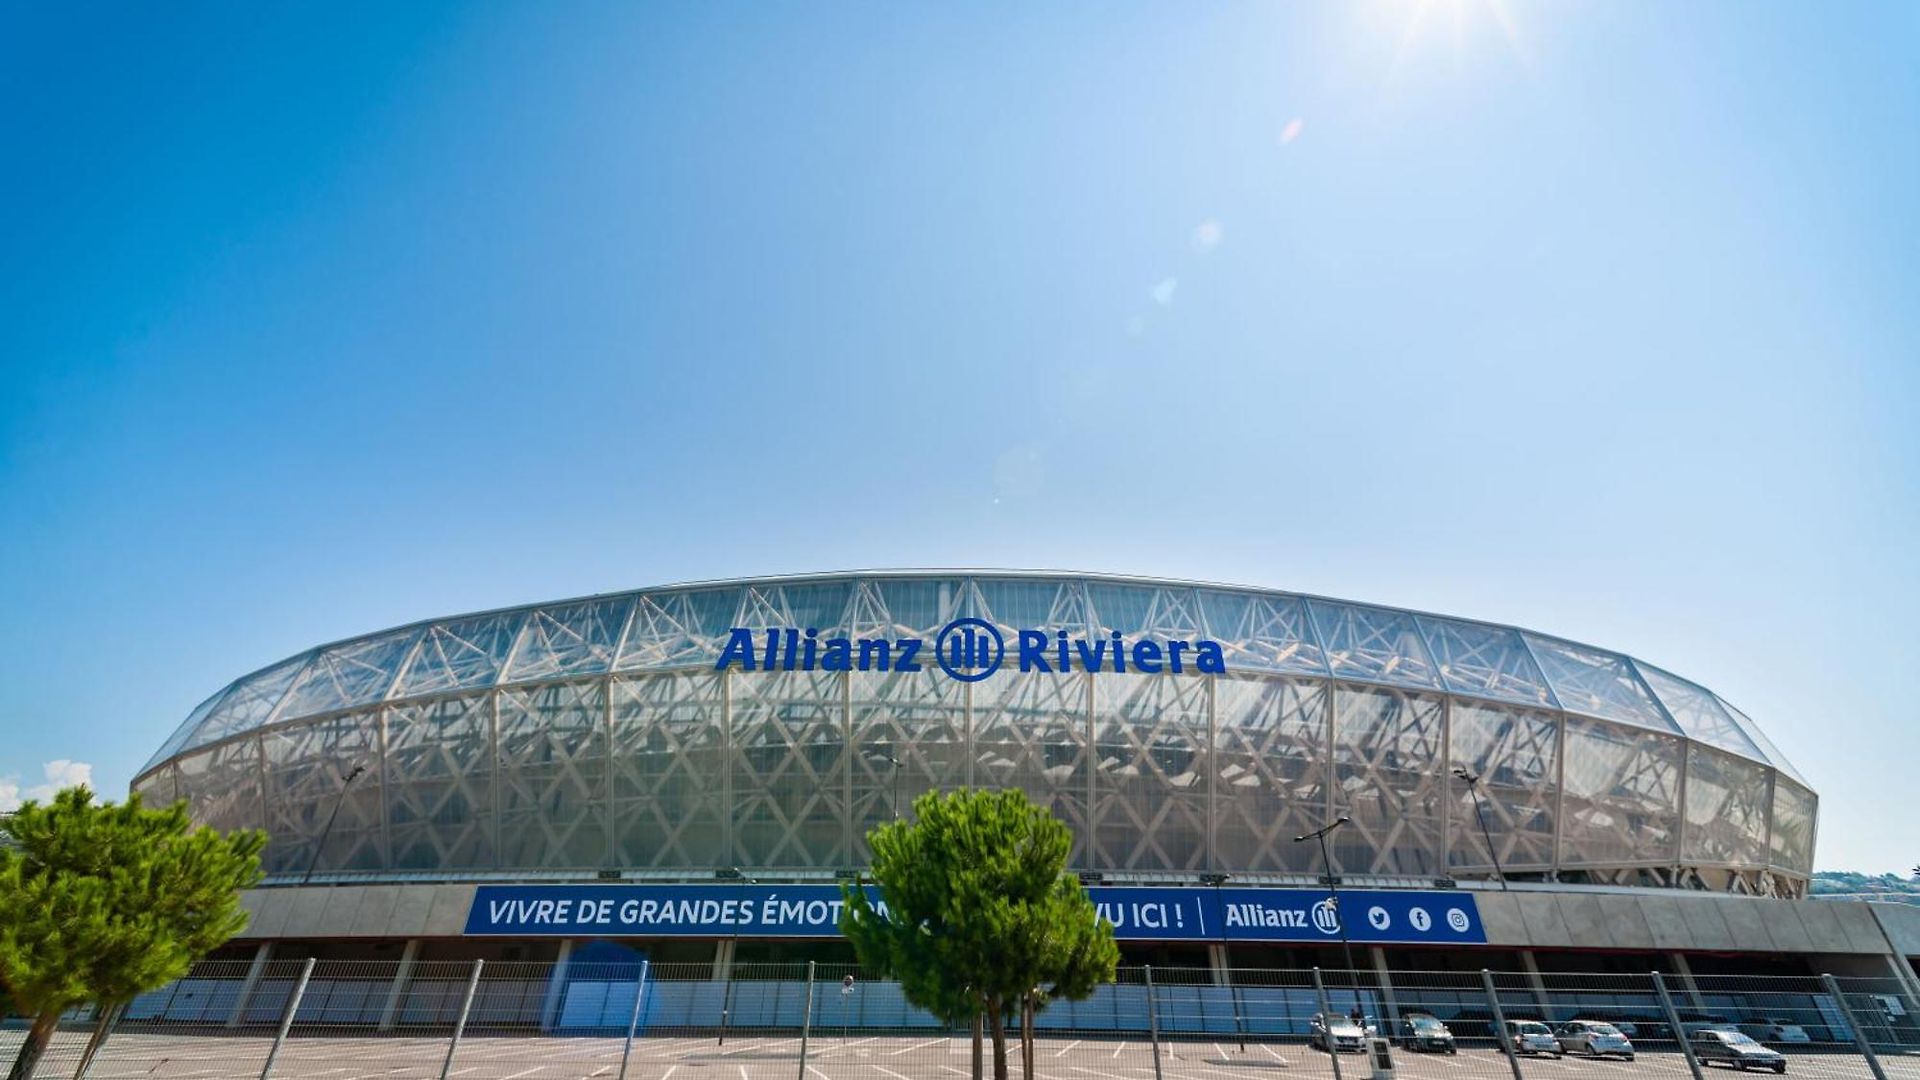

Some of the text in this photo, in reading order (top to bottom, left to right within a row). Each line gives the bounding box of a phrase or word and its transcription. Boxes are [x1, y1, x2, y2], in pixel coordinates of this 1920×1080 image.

[717, 627, 1226, 673] Allianz Riviera
[490, 900, 572, 925] VIVRE
[577, 900, 614, 925] DE
[620, 899, 754, 925] GRANDES
[1132, 903, 1168, 928] ICI
[1226, 904, 1308, 928] Allianz
